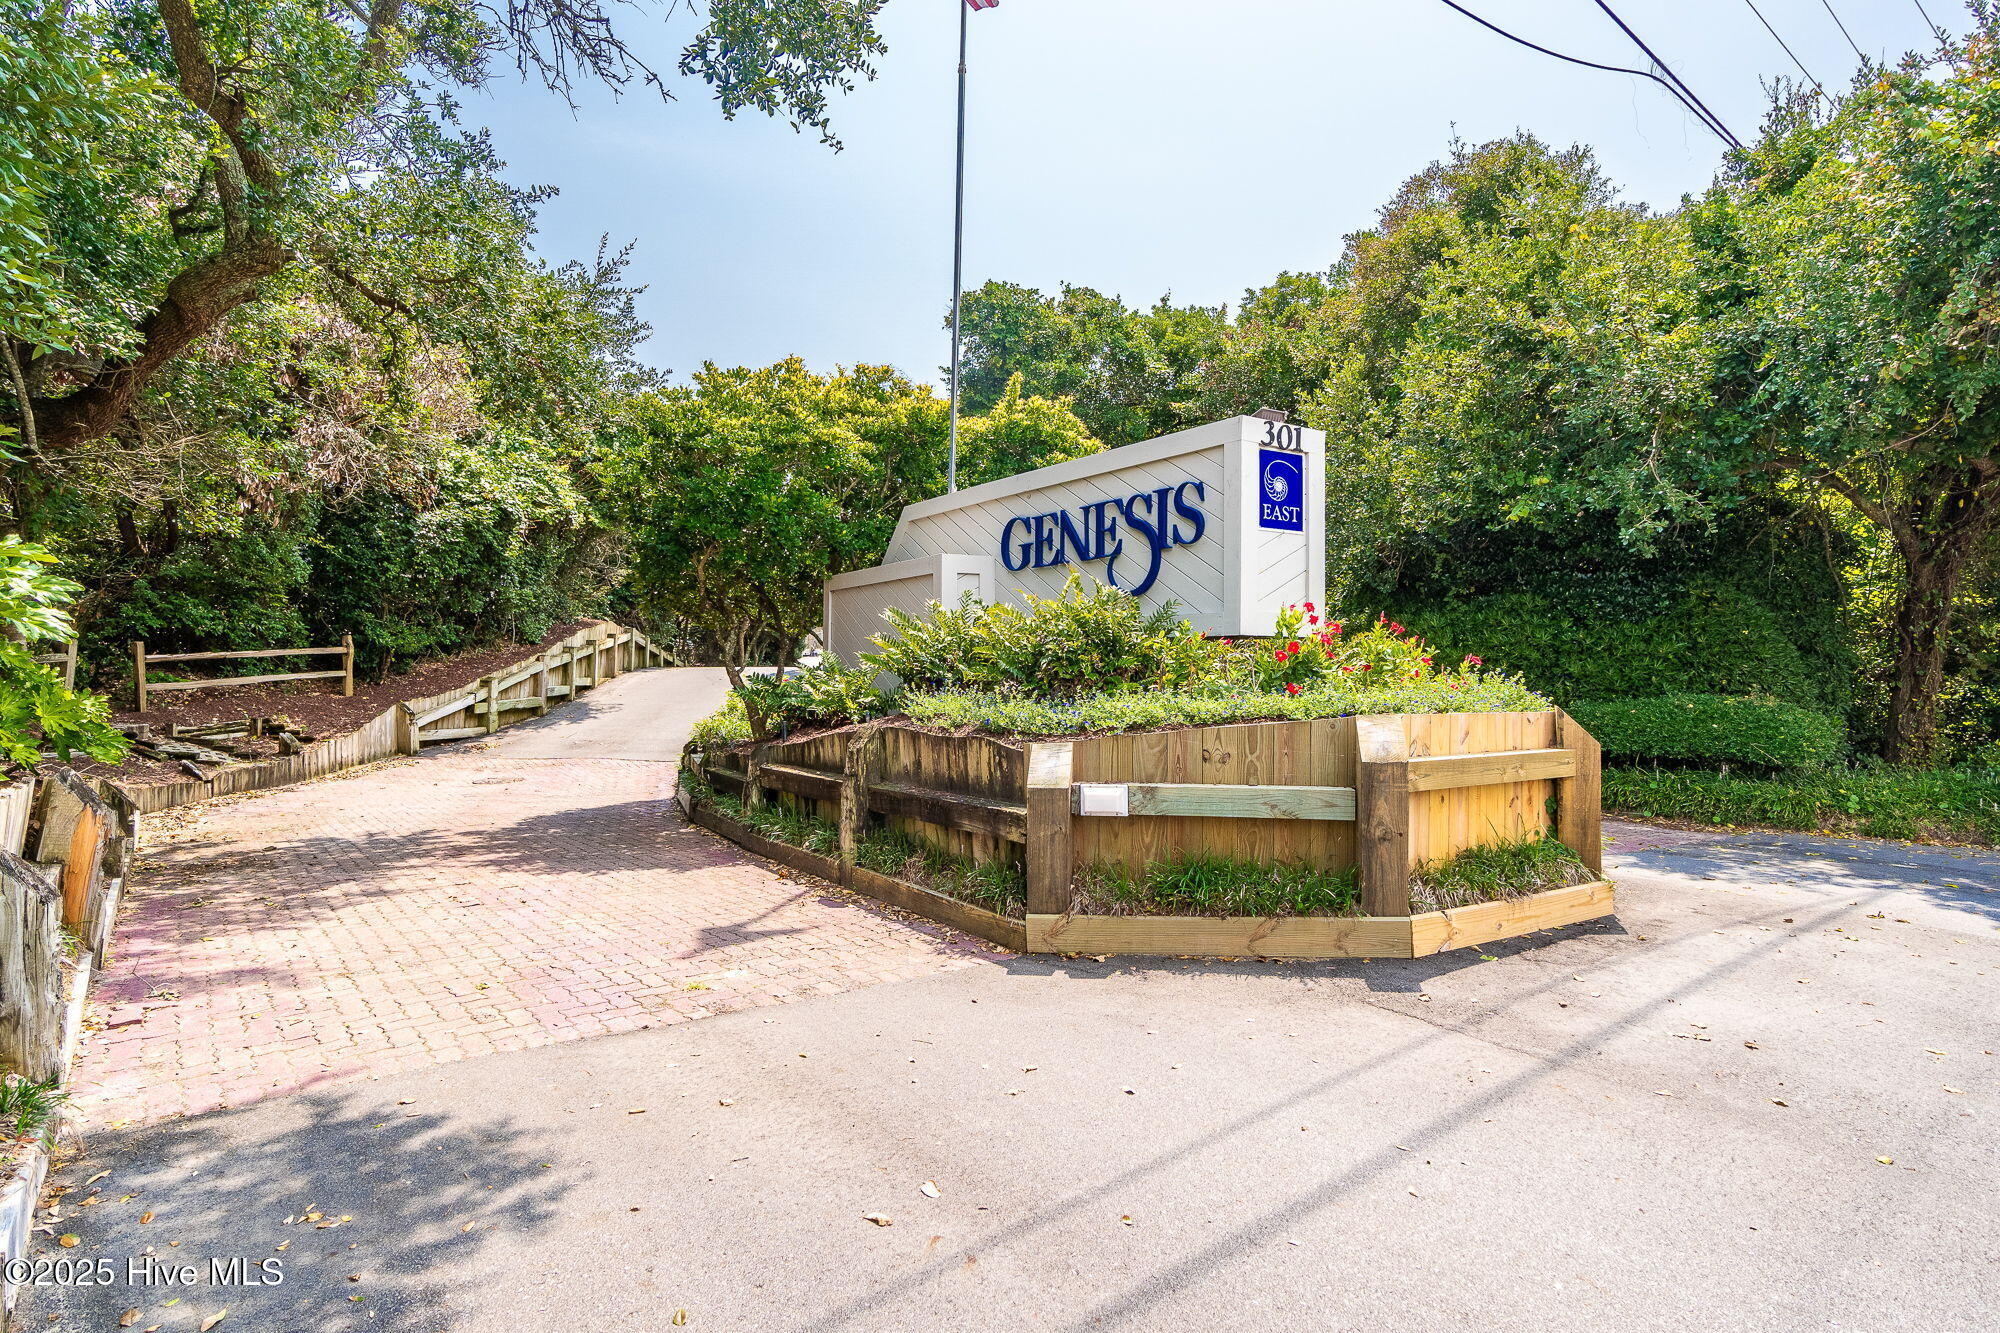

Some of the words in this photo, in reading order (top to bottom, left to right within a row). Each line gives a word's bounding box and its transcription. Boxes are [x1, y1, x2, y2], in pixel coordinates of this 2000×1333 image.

[1261, 421, 1303, 452] 301
[1262, 503, 1300, 523] EAST
[1001, 481, 1205, 596] GENESIS
